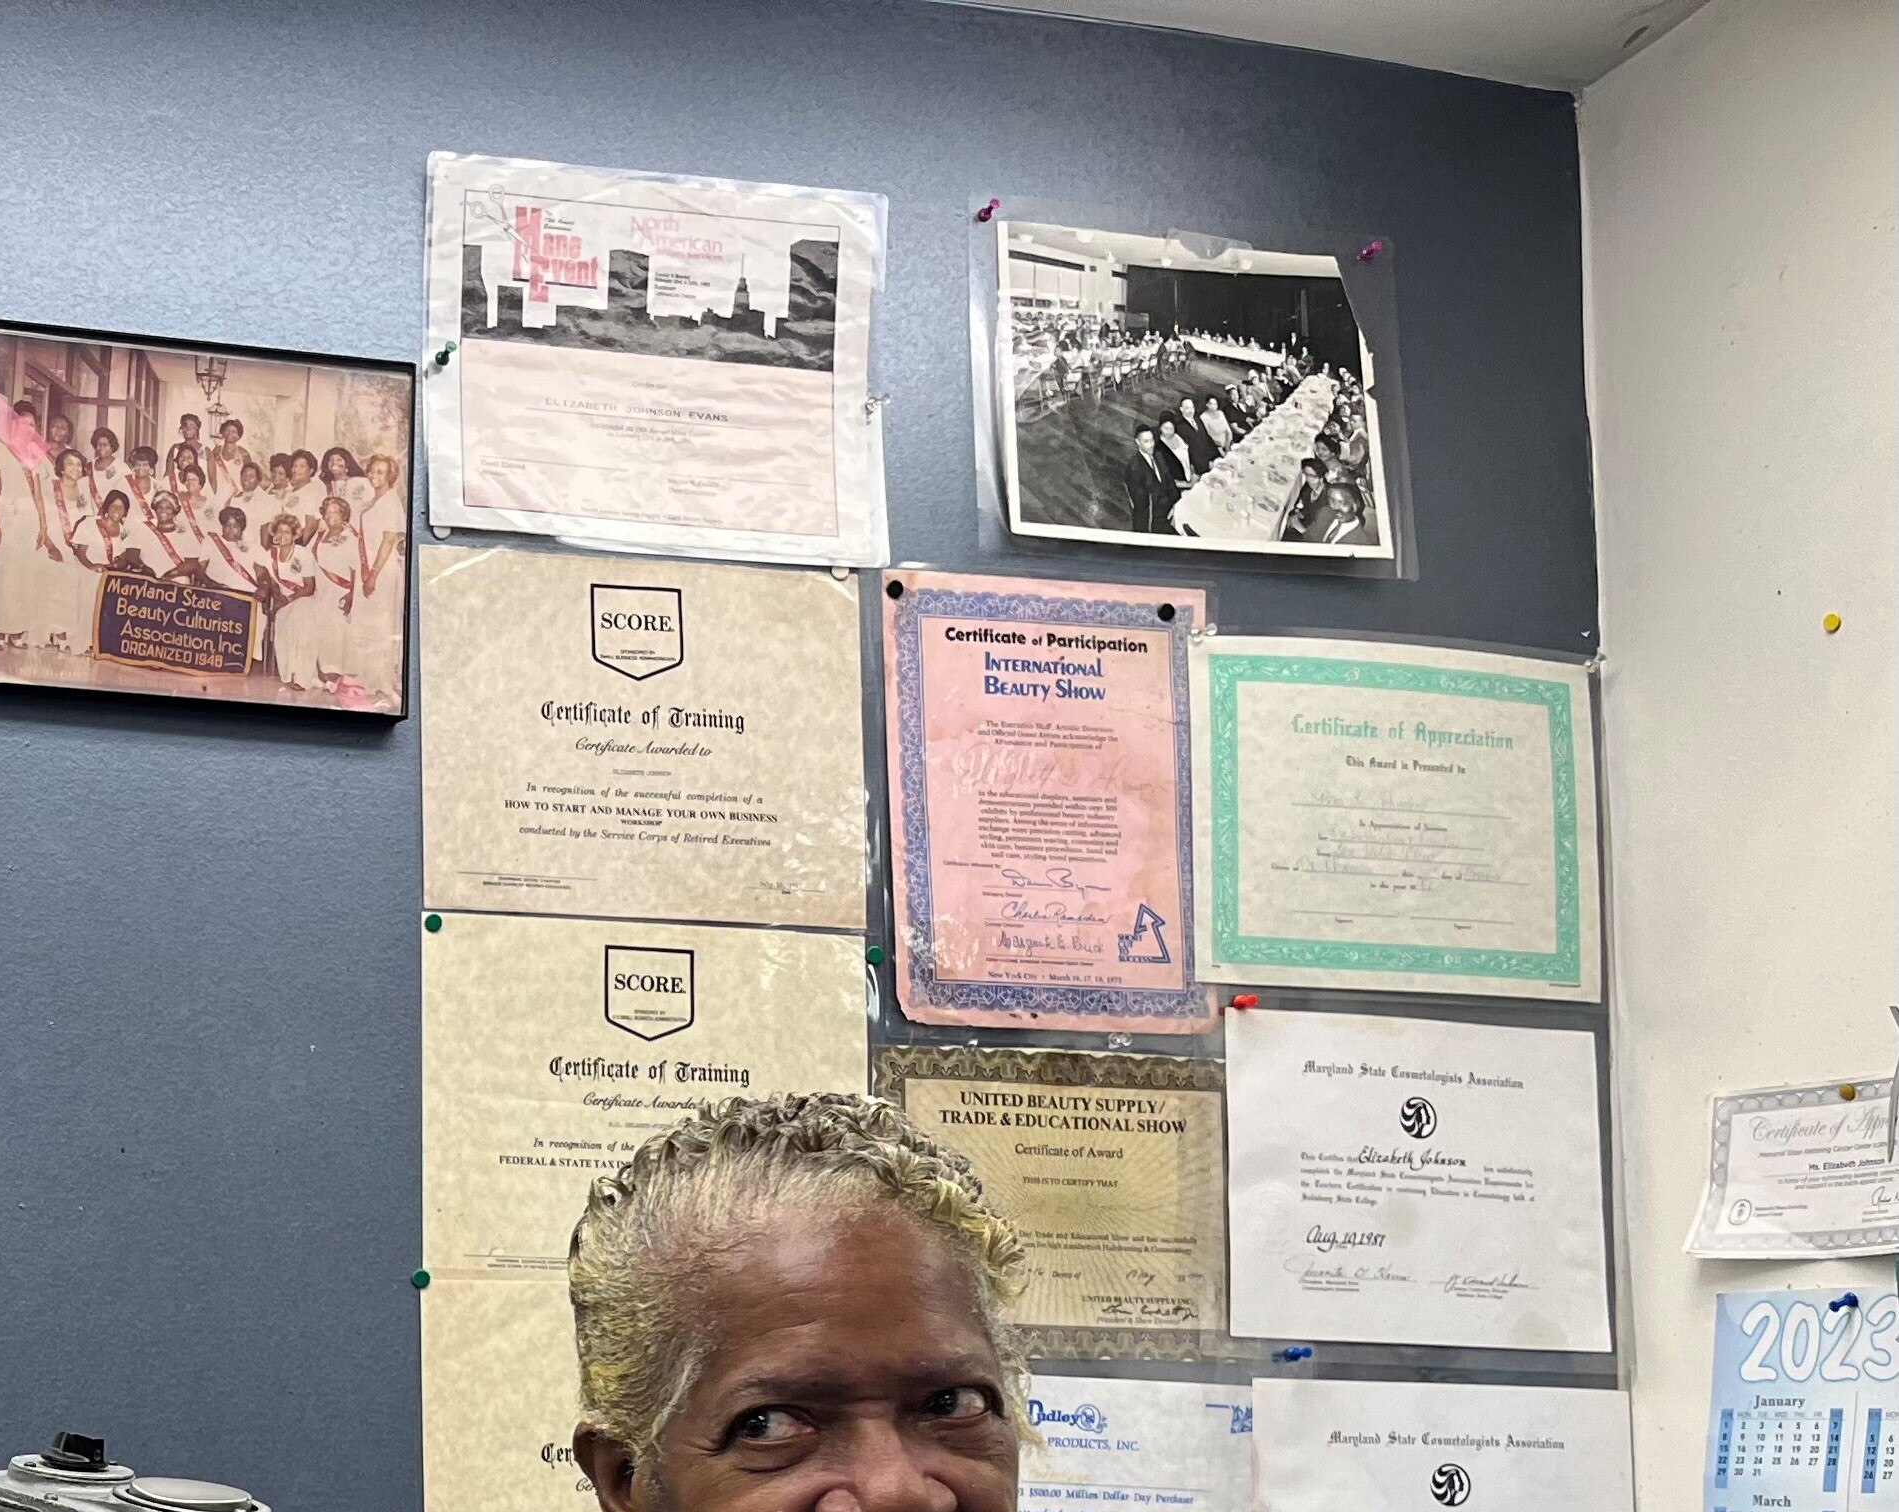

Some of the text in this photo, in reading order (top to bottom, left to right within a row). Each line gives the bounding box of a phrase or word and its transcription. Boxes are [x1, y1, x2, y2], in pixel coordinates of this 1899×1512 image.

[631, 215, 679, 239] North
[639, 230, 723, 253] American
[544, 397, 729, 422] ELIZABETH JOHNSON EVANS
[107, 579, 221, 610] Maryland State
[116, 598, 242, 634] Beauty Culturists
[120, 619, 216, 651] Association,
[945, 627, 1148, 653] Certificate of Participation
[121, 639, 223, 668] ORGANIZED 1948
[541, 700, 745, 734] Certificate of Training
[1291, 713, 1514, 750] Certificate of Appreciation
[575, 737, 712, 757] Certificate Awarded to
[505, 800, 778, 823] HOW TO START AND MANAGE YOUR OWN BUSINESS
[549, 1056, 750, 1087] Certificate of Training
[1302, 1060, 1524, 1089] Maryland State Cosmetologists Association
[960, 1091, 1023, 1107] UNITED
[1028, 1095, 1091, 1111] BEAUTY
[939, 1110, 1186, 1134] TRADE & EDUCATIONAL SHOW
[499, 1155, 615, 1169] FEDERAL & STATE TAX
[1015, 1144, 1123, 1159] Certificate of Award
[1358, 1146, 1467, 1171] Elizabeth Johnson
[1739, 1294, 1899, 1382] 2023
[1753, 1395, 1806, 1409] January
[1047, 1436, 1140, 1451] PRODUCTS, INC.
[1752, 1495, 1791, 1509] March
